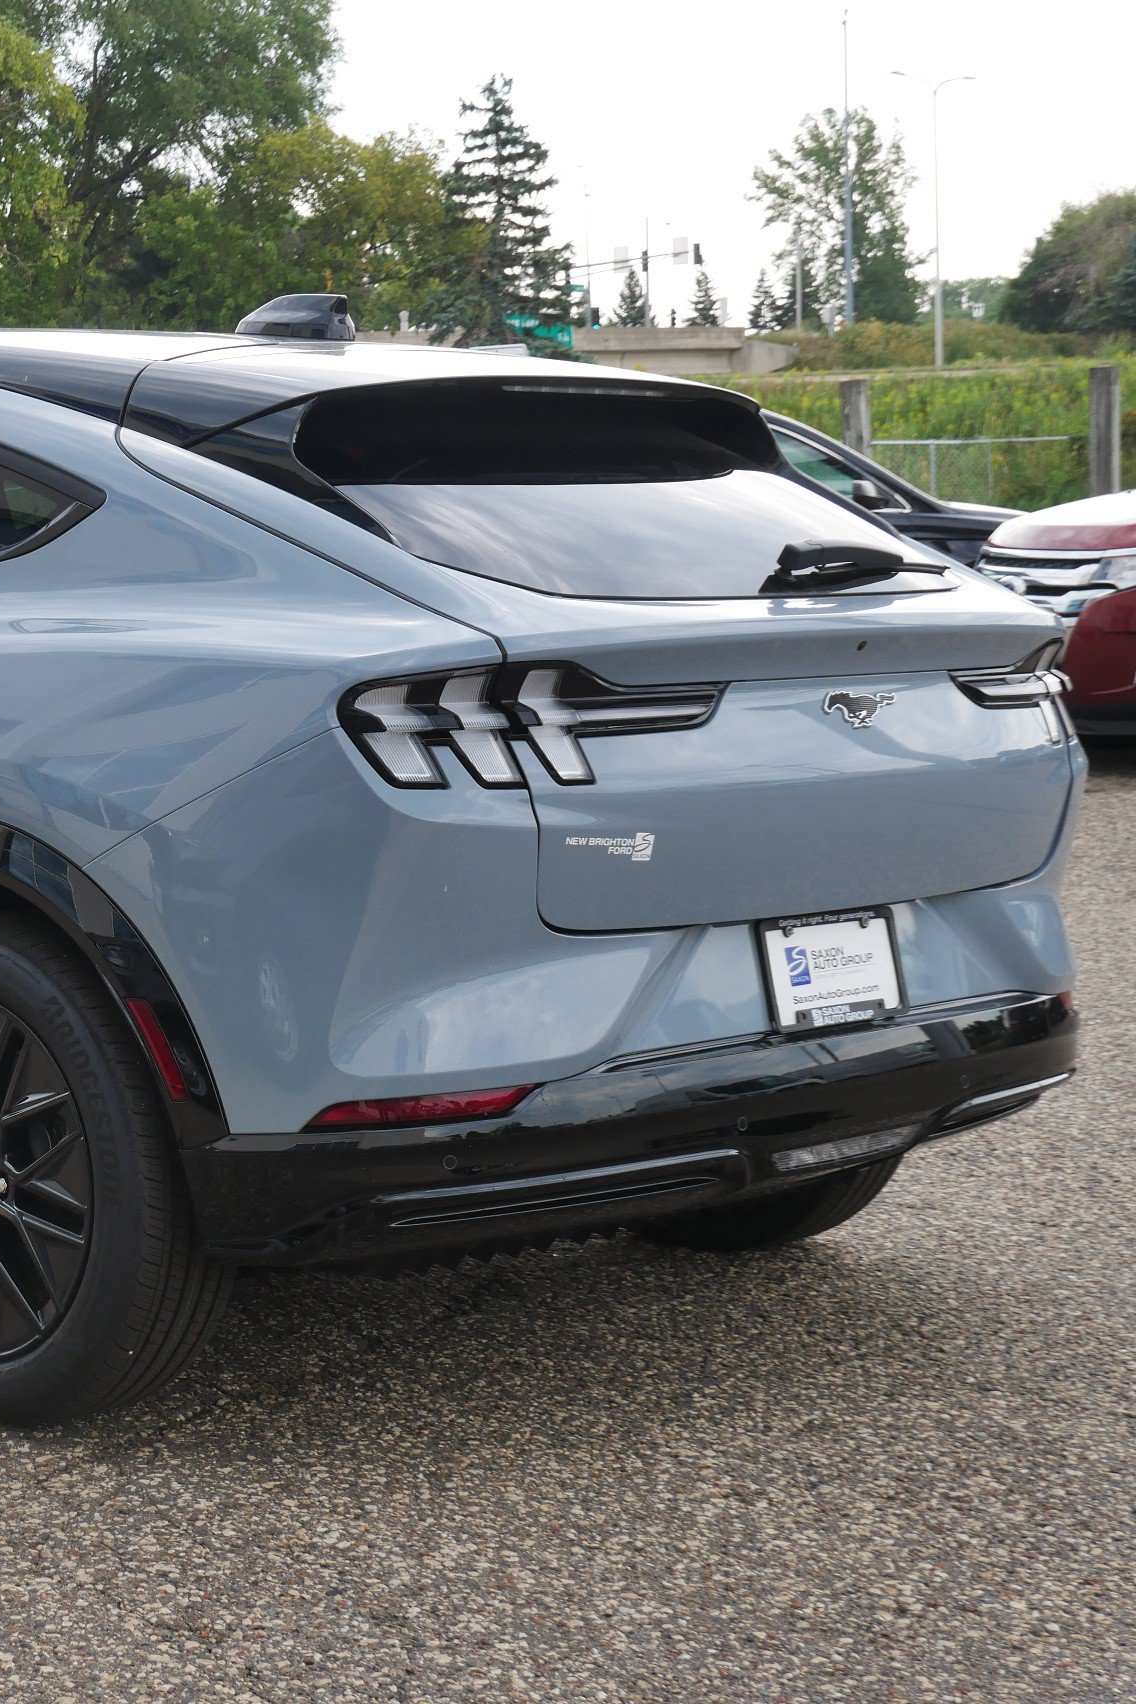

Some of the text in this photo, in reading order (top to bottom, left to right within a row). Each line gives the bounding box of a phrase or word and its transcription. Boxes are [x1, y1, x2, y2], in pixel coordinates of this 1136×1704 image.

[565, 837, 635, 846] NEW BRIGHTON
[607, 847, 633, 855] FORD
[778, 919, 801, 927] Getting
[811, 946, 844, 960] SAXON
[813, 952, 873, 970] AUTO GROUP
[793, 984, 880, 1004] SaxonAutoGroup.com
[822, 1004, 850, 1016] SAXON
[823, 1009, 875, 1024] AUTO GROUP
